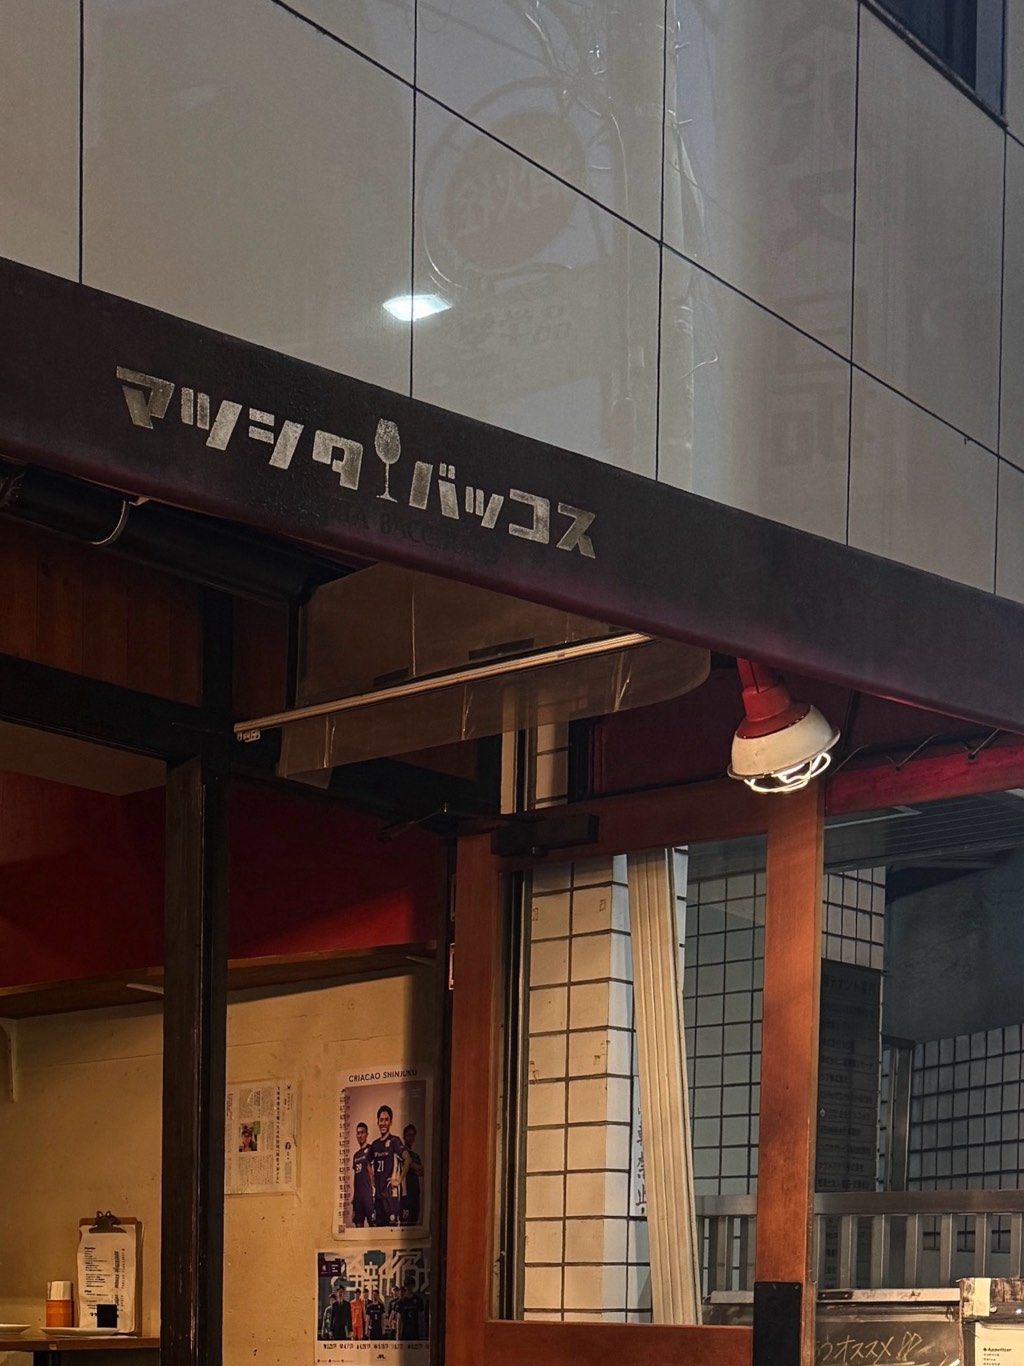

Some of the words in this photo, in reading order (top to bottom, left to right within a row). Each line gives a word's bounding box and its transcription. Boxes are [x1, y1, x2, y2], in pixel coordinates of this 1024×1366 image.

[115, 365, 364, 491] マツシタ
[409, 460, 597, 560] バッコス
[349, 1073, 381, 1083] CRIACAO
